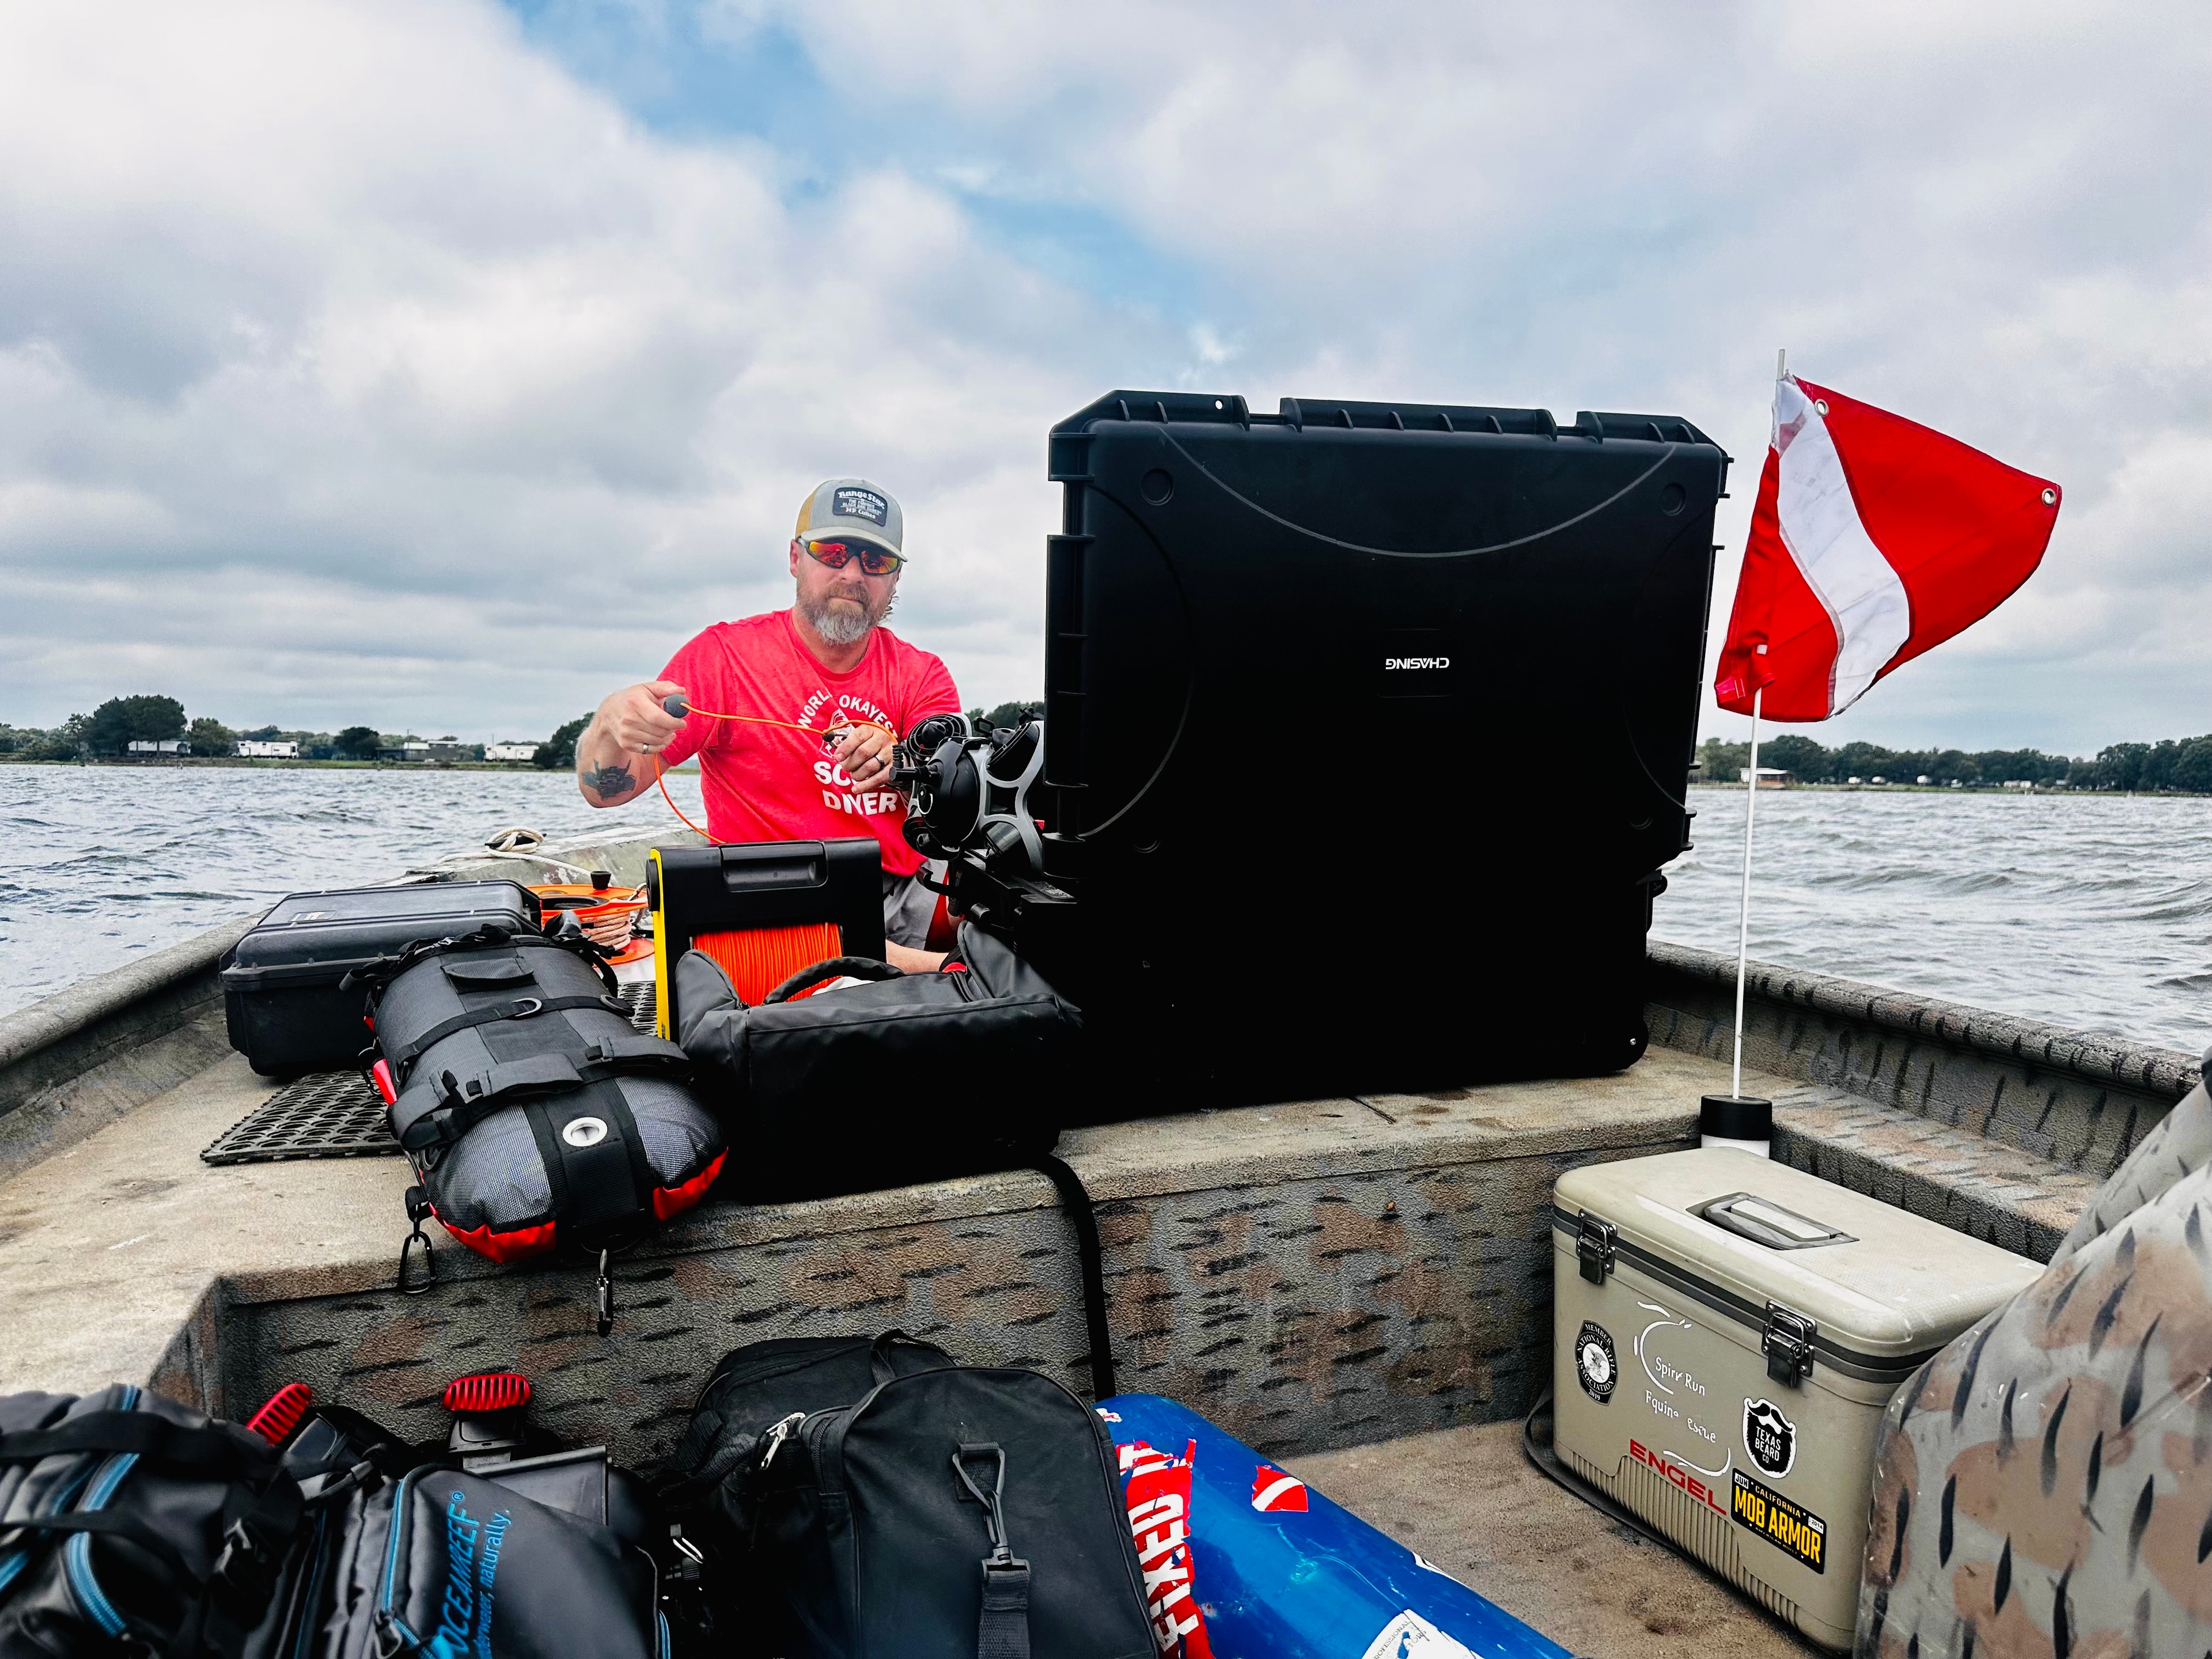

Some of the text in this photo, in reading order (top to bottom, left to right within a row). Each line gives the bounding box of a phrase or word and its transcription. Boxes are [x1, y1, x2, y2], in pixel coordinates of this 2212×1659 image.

[1385, 657, 1450, 670] CHASING
[797, 690, 833, 728] WORL
[1585, 1323, 1611, 1346] MEMBER
[1577, 1334, 1616, 1376] NATIONAL RIFLE
[1577, 1358, 1615, 1392] ASSOCIATION
[1685, 1373, 1705, 1396] Run
[1588, 1388, 1600, 1401] 2019
[1755, 1437, 1779, 1461] BEARD
[1756, 1426, 1781, 1451] TEXAS
[1629, 1438, 1727, 1516] ENGEL
[1735, 1475, 1801, 1518] JUN CALIFORNIA
[1735, 1485, 1821, 1564] MOB ARMOR
[1811, 1520, 1823, 1529] 2014
[479, 1508, 512, 1588] naturally.
[1127, 1493, 1199, 1652] FIXED
[1373, 1620, 1412, 1659] ROFESSIONAL
